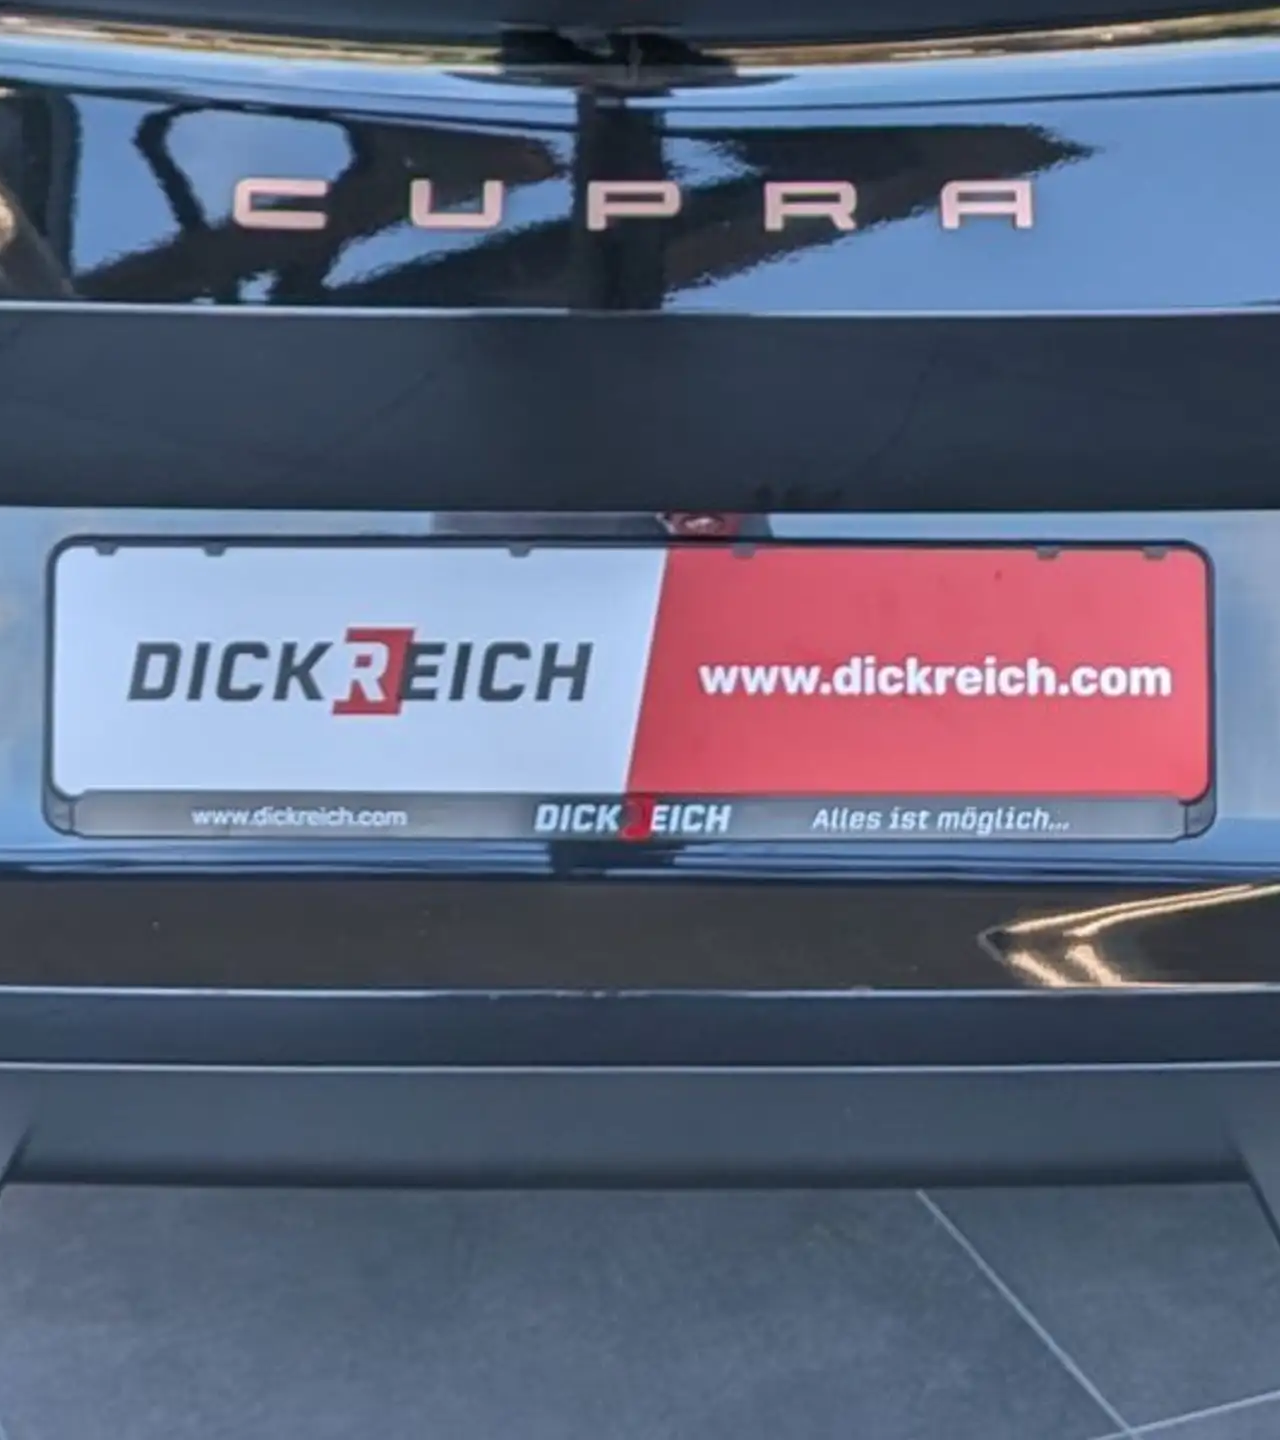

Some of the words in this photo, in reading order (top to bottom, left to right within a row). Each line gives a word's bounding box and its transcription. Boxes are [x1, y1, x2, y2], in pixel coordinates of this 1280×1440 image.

[233, 177, 1036, 232] CUPRA
[128, 637, 593, 704] DICKREICH
[700, 655, 1173, 698] www.dickreich.com
[191, 805, 408, 827] www.dickreich.com
[534, 801, 732, 837] DICKEICH
[811, 806, 882, 830] Alles
[888, 807, 931, 830] ist
[936, 806, 1070, 836] möglich...
